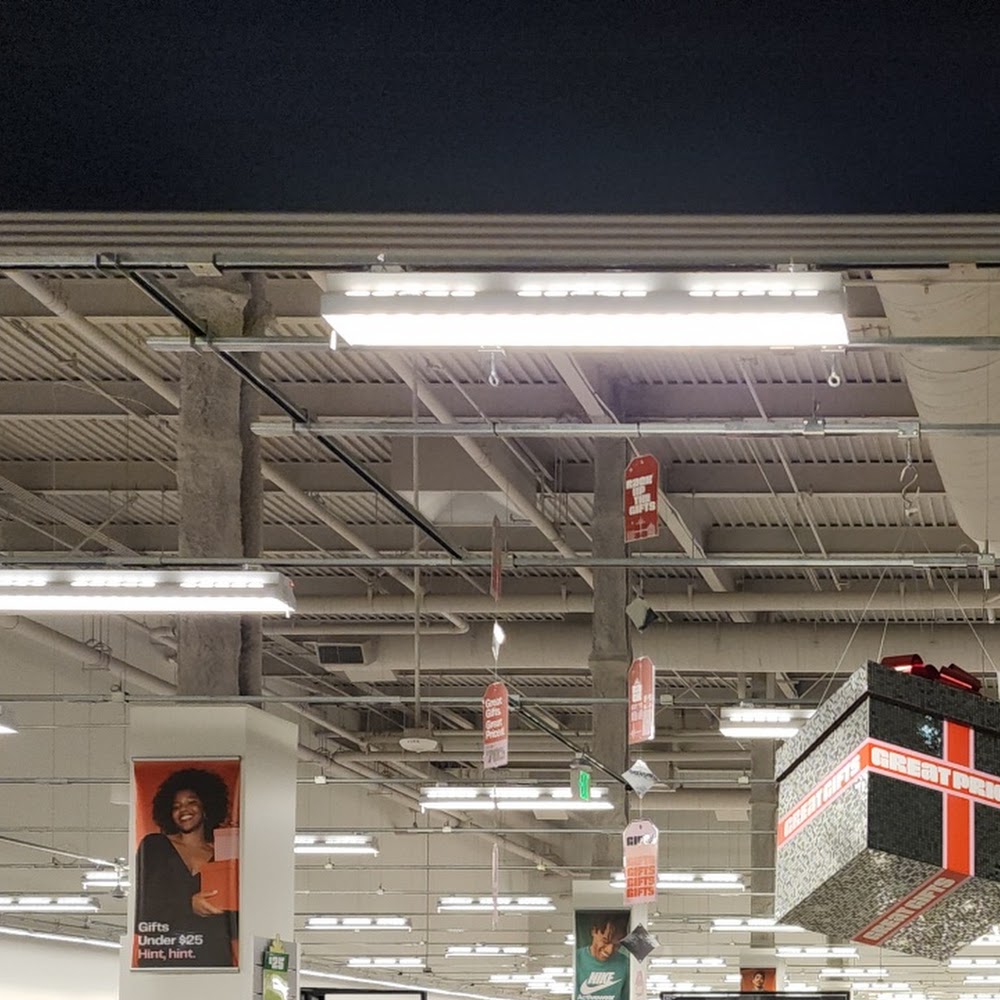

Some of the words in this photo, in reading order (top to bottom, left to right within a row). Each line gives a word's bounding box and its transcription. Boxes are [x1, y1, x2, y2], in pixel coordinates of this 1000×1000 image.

[628, 501, 656, 515] GIFTS
[871, 748, 951, 787] GREAT
[822, 754, 861, 803] GIFTS
[627, 866, 655, 876] GIFTS
[627, 877, 654, 887] GIFTS
[627, 887, 654, 898] GIFTS
[138, 922, 169, 933] Gifts
[138, 935, 176, 946] Under
[178, 934, 204, 946] $25
[138, 948, 166, 961] Hint,
[168, 948, 196, 959] hint.
[588, 972, 615, 985] NIKE
